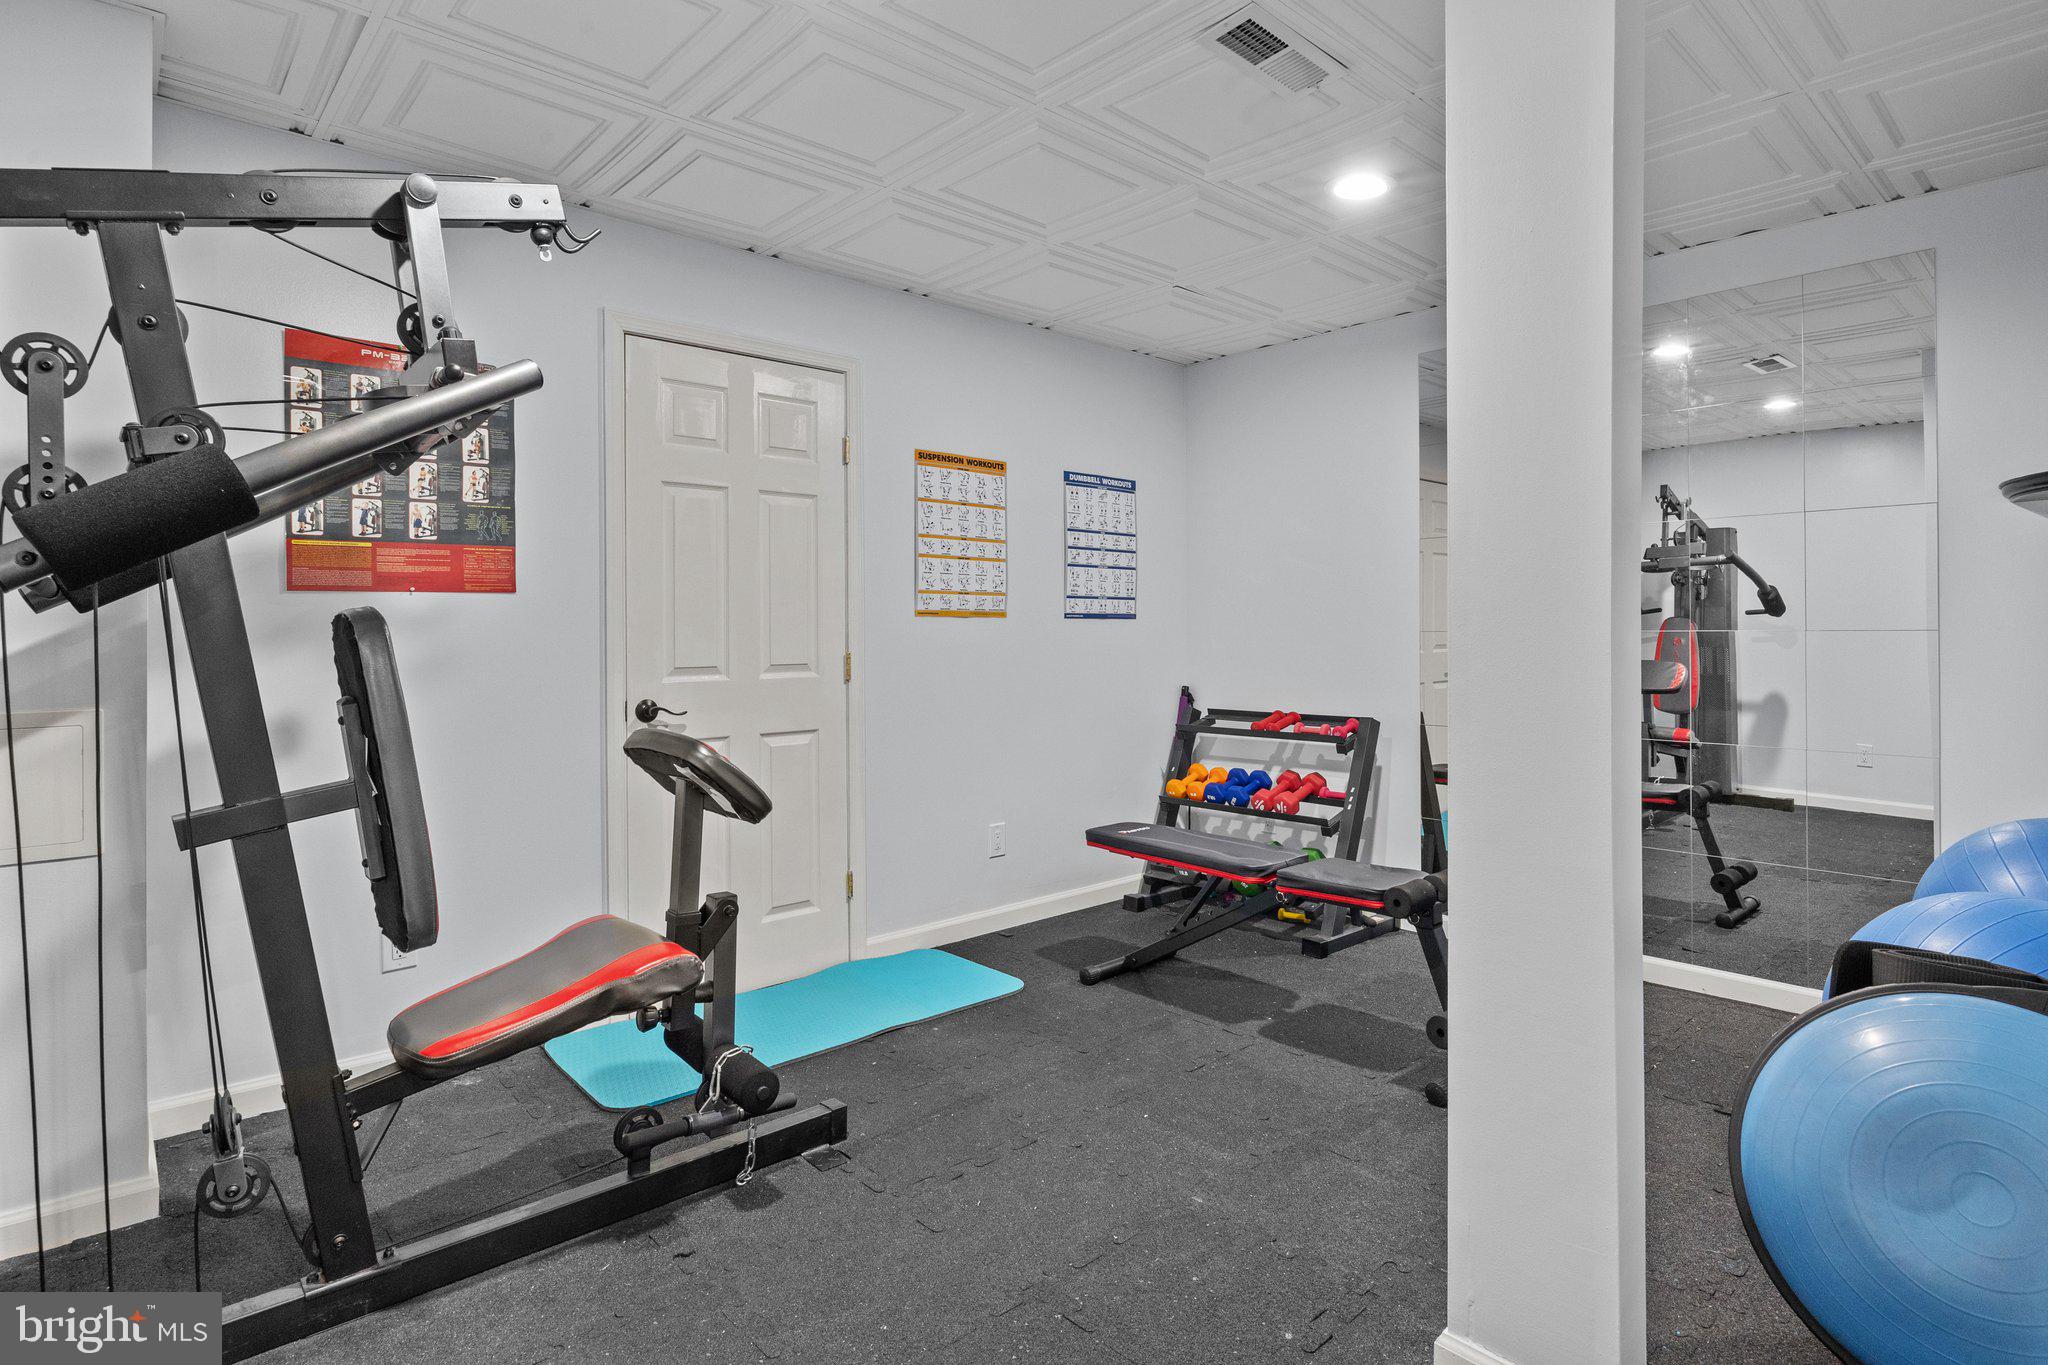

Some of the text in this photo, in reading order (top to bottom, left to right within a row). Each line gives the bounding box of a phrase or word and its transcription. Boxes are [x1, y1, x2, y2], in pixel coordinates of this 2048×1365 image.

[917, 451, 1005, 471] SUSPENSION WORKOUTS
[1069, 473, 1132, 489] DUMBBELL WORKOUTS
